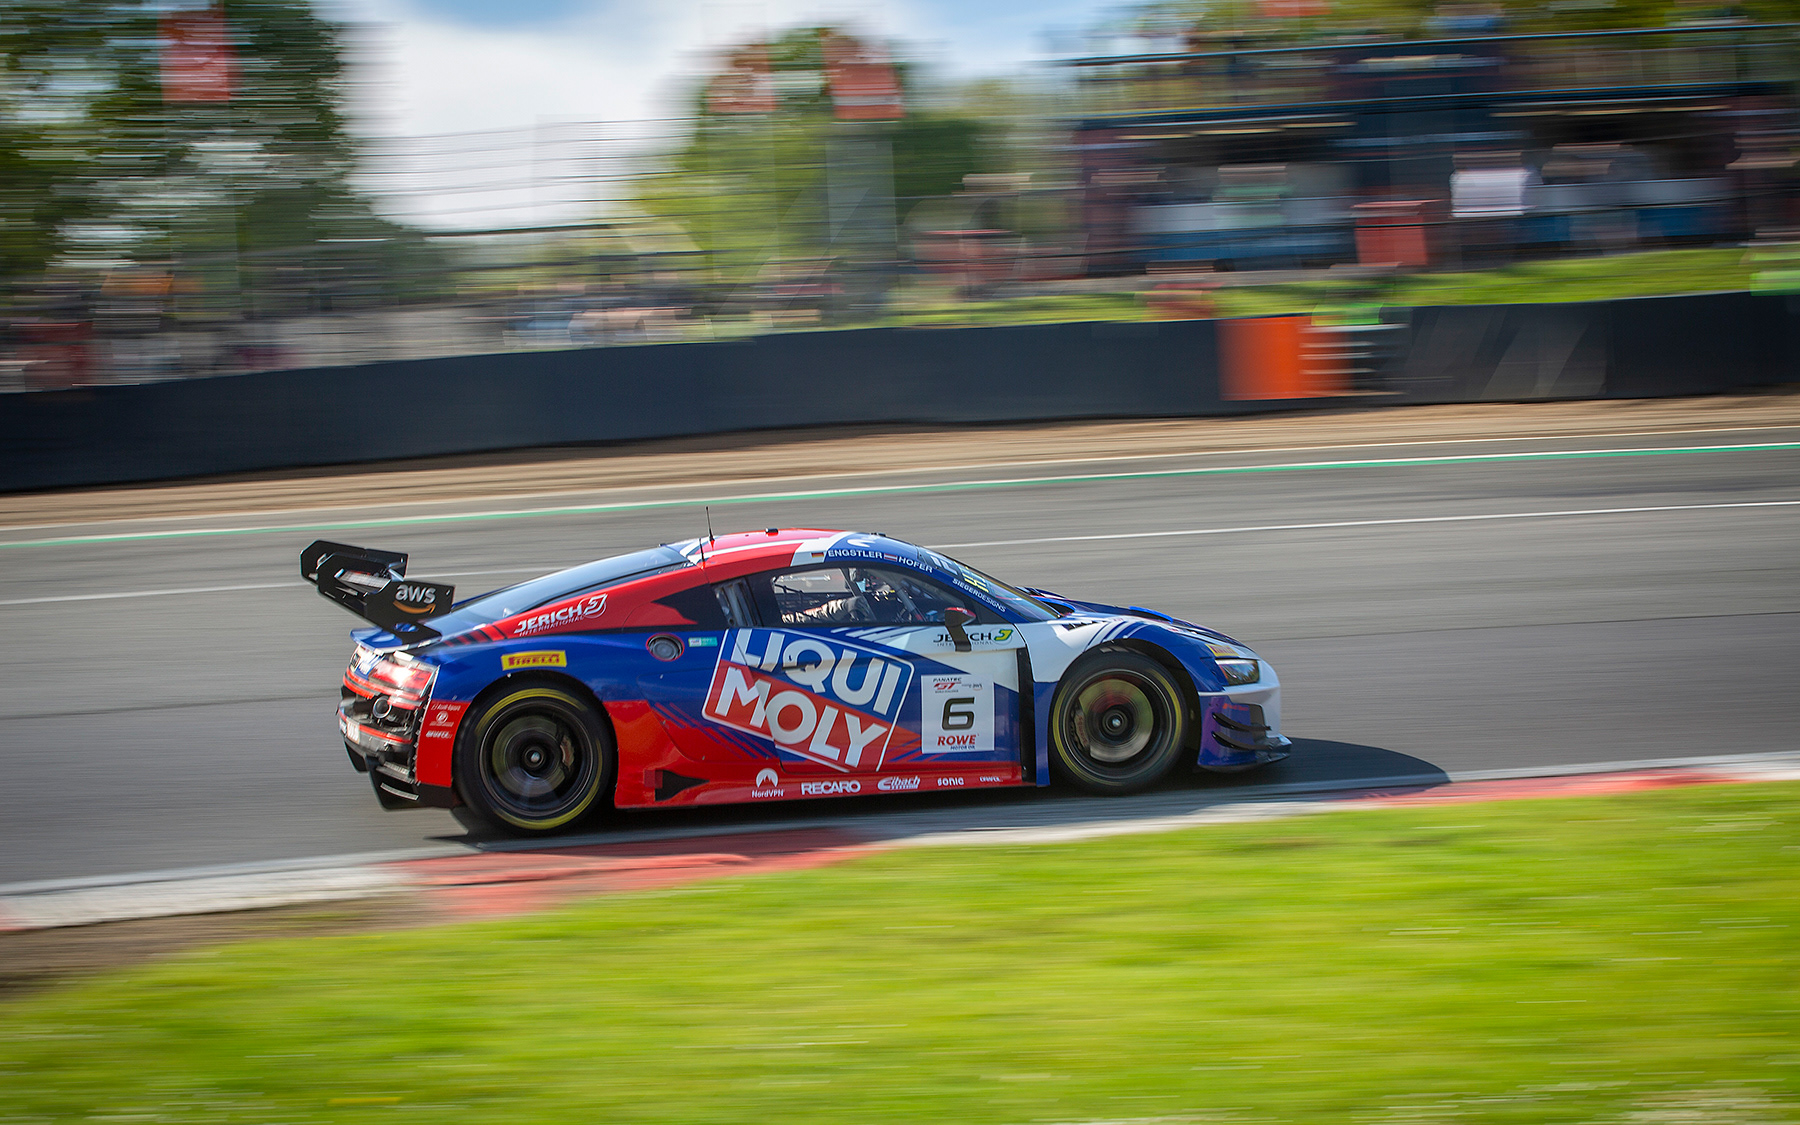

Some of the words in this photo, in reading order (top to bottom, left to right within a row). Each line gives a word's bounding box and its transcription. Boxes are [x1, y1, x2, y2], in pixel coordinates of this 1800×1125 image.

[828, 549, 882, 559] ENGSTLER
[899, 556, 933, 574] HOFER
[395, 584, 436, 604] aws
[952, 577, 1006, 612] SIEGERDESIGNS
[513, 605, 584, 634] JERICH
[933, 632, 992, 643] JECH
[730, 628, 902, 716] LIQUI
[714, 666, 889, 769] MOLY
[942, 697, 975, 731] 6
[937, 735, 977, 746] ROWE
[751, 789, 784, 798] NordVPN
[801, 781, 861, 795] RECARO
